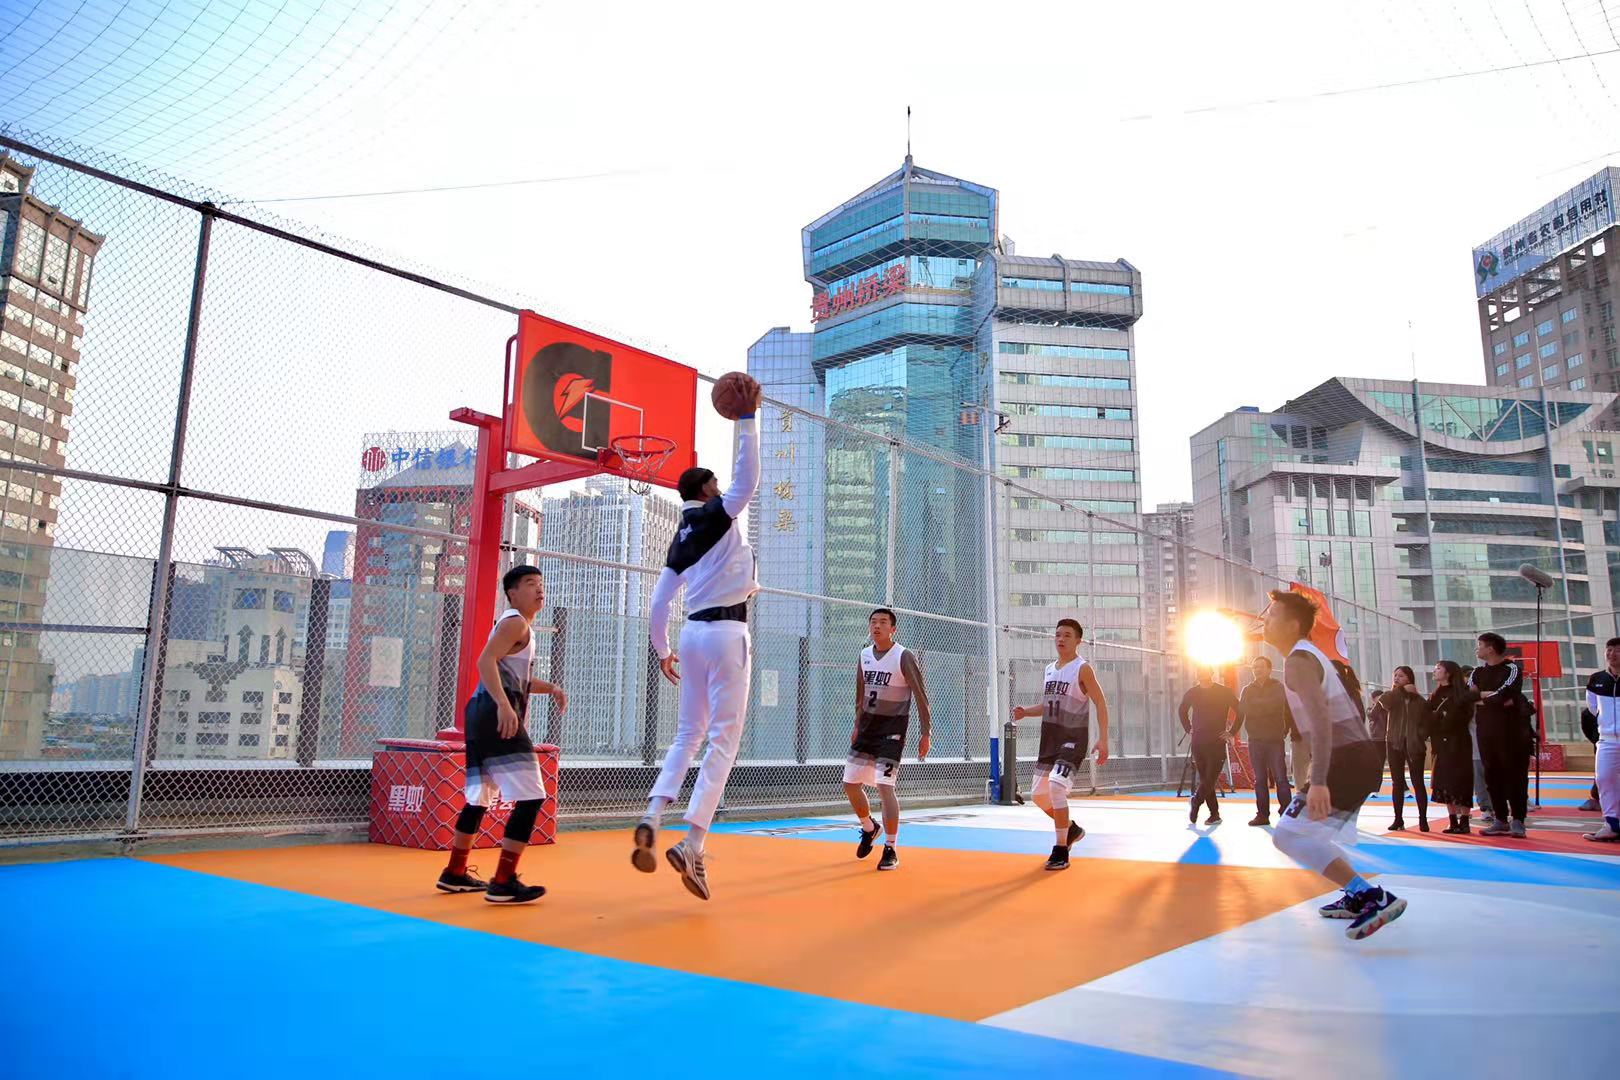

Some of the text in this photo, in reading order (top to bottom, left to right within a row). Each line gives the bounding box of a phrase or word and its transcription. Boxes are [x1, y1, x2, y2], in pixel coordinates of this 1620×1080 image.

[1556, 217, 1583, 235] CREDIT
[1583, 202, 1608, 220] UNION
[810, 264, 906, 323] 贵州桥梁
[868, 690, 878, 707] 2
[1048, 700, 1060, 717] 11
[884, 763, 893, 777] 2
